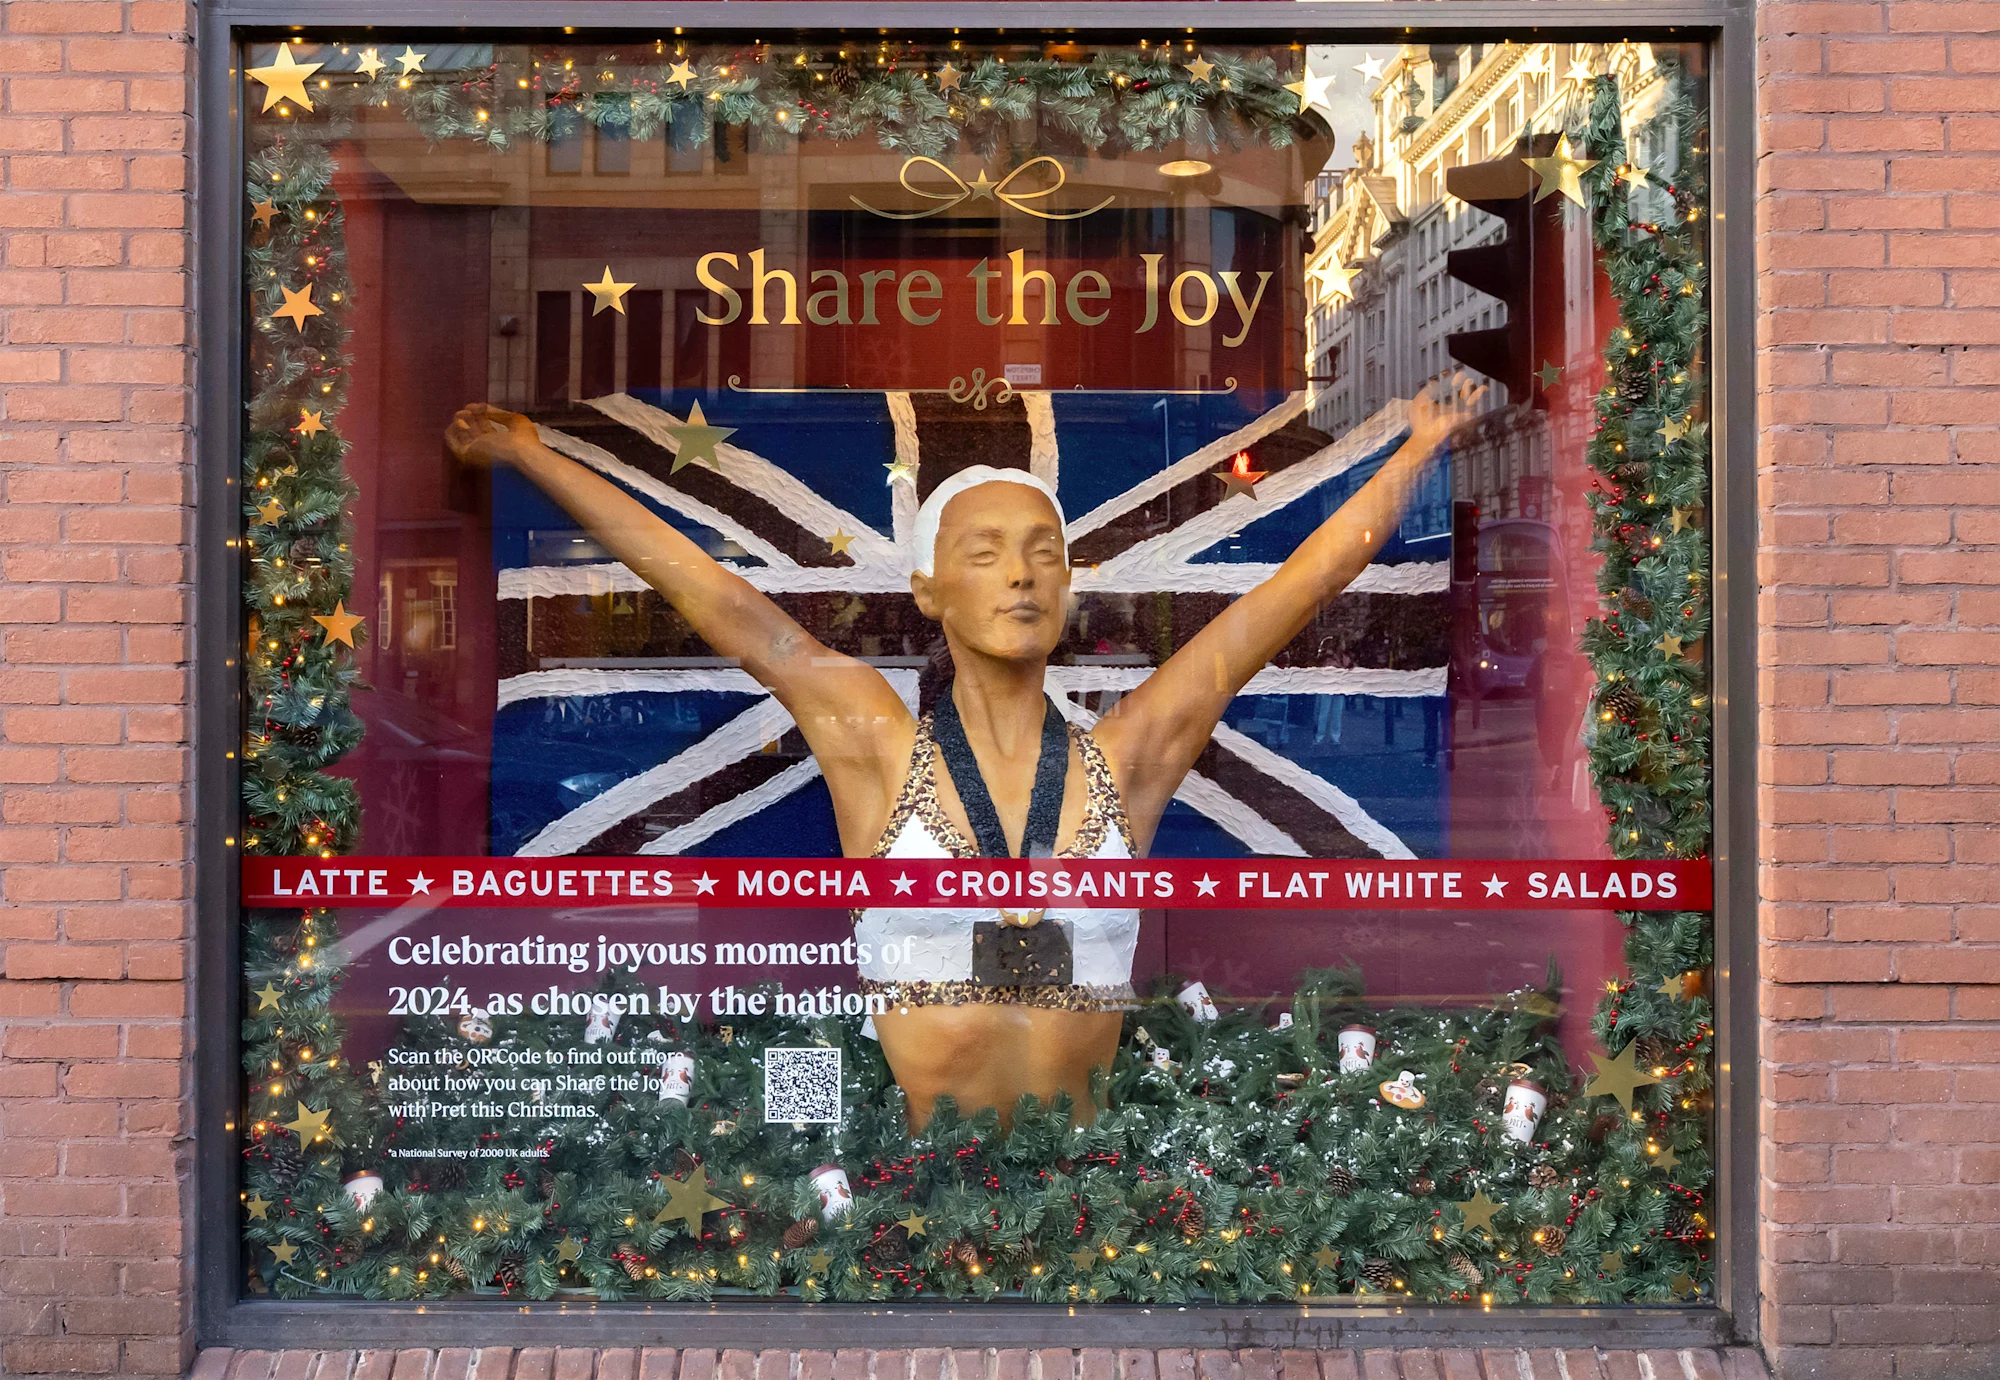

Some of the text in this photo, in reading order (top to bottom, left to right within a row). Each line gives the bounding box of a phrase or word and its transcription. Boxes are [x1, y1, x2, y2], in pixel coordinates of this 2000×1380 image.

[695, 248, 1273, 348] Share the Joy
[273, 869, 1678, 899] LATTE BAGUETTES MOCHA CROISSANTS FLAT WHITE SALADS
[388, 935, 918, 973] Celebrating joyous moments of
[388, 986, 478, 1019] 2024,
[487, 991, 523, 1015] as
[530, 985, 651, 1015] chosen
[658, 985, 702, 1023] by
[708, 985, 766, 1015] the
[388, 1048, 430, 1065] Scan
[434, 1048, 463, 1065] the
[466, 1048, 494, 1067] QR
[496, 1048, 541, 1065] Code
[545, 1050, 563, 1065] to
[567, 1048, 602, 1065] find
[606, 1049, 640, 1065] out
[388, 1075, 668, 1095] about how you can Share the Joy
[388, 1101, 599, 1118] with Pret this Christmas.
[398, 1148, 436, 1158] National
[437, 1149, 467, 1160] Survey
[469, 1149, 479, 1158] of
[479, 1149, 503, 1158] 2000
[505, 1149, 518, 1158] UK
